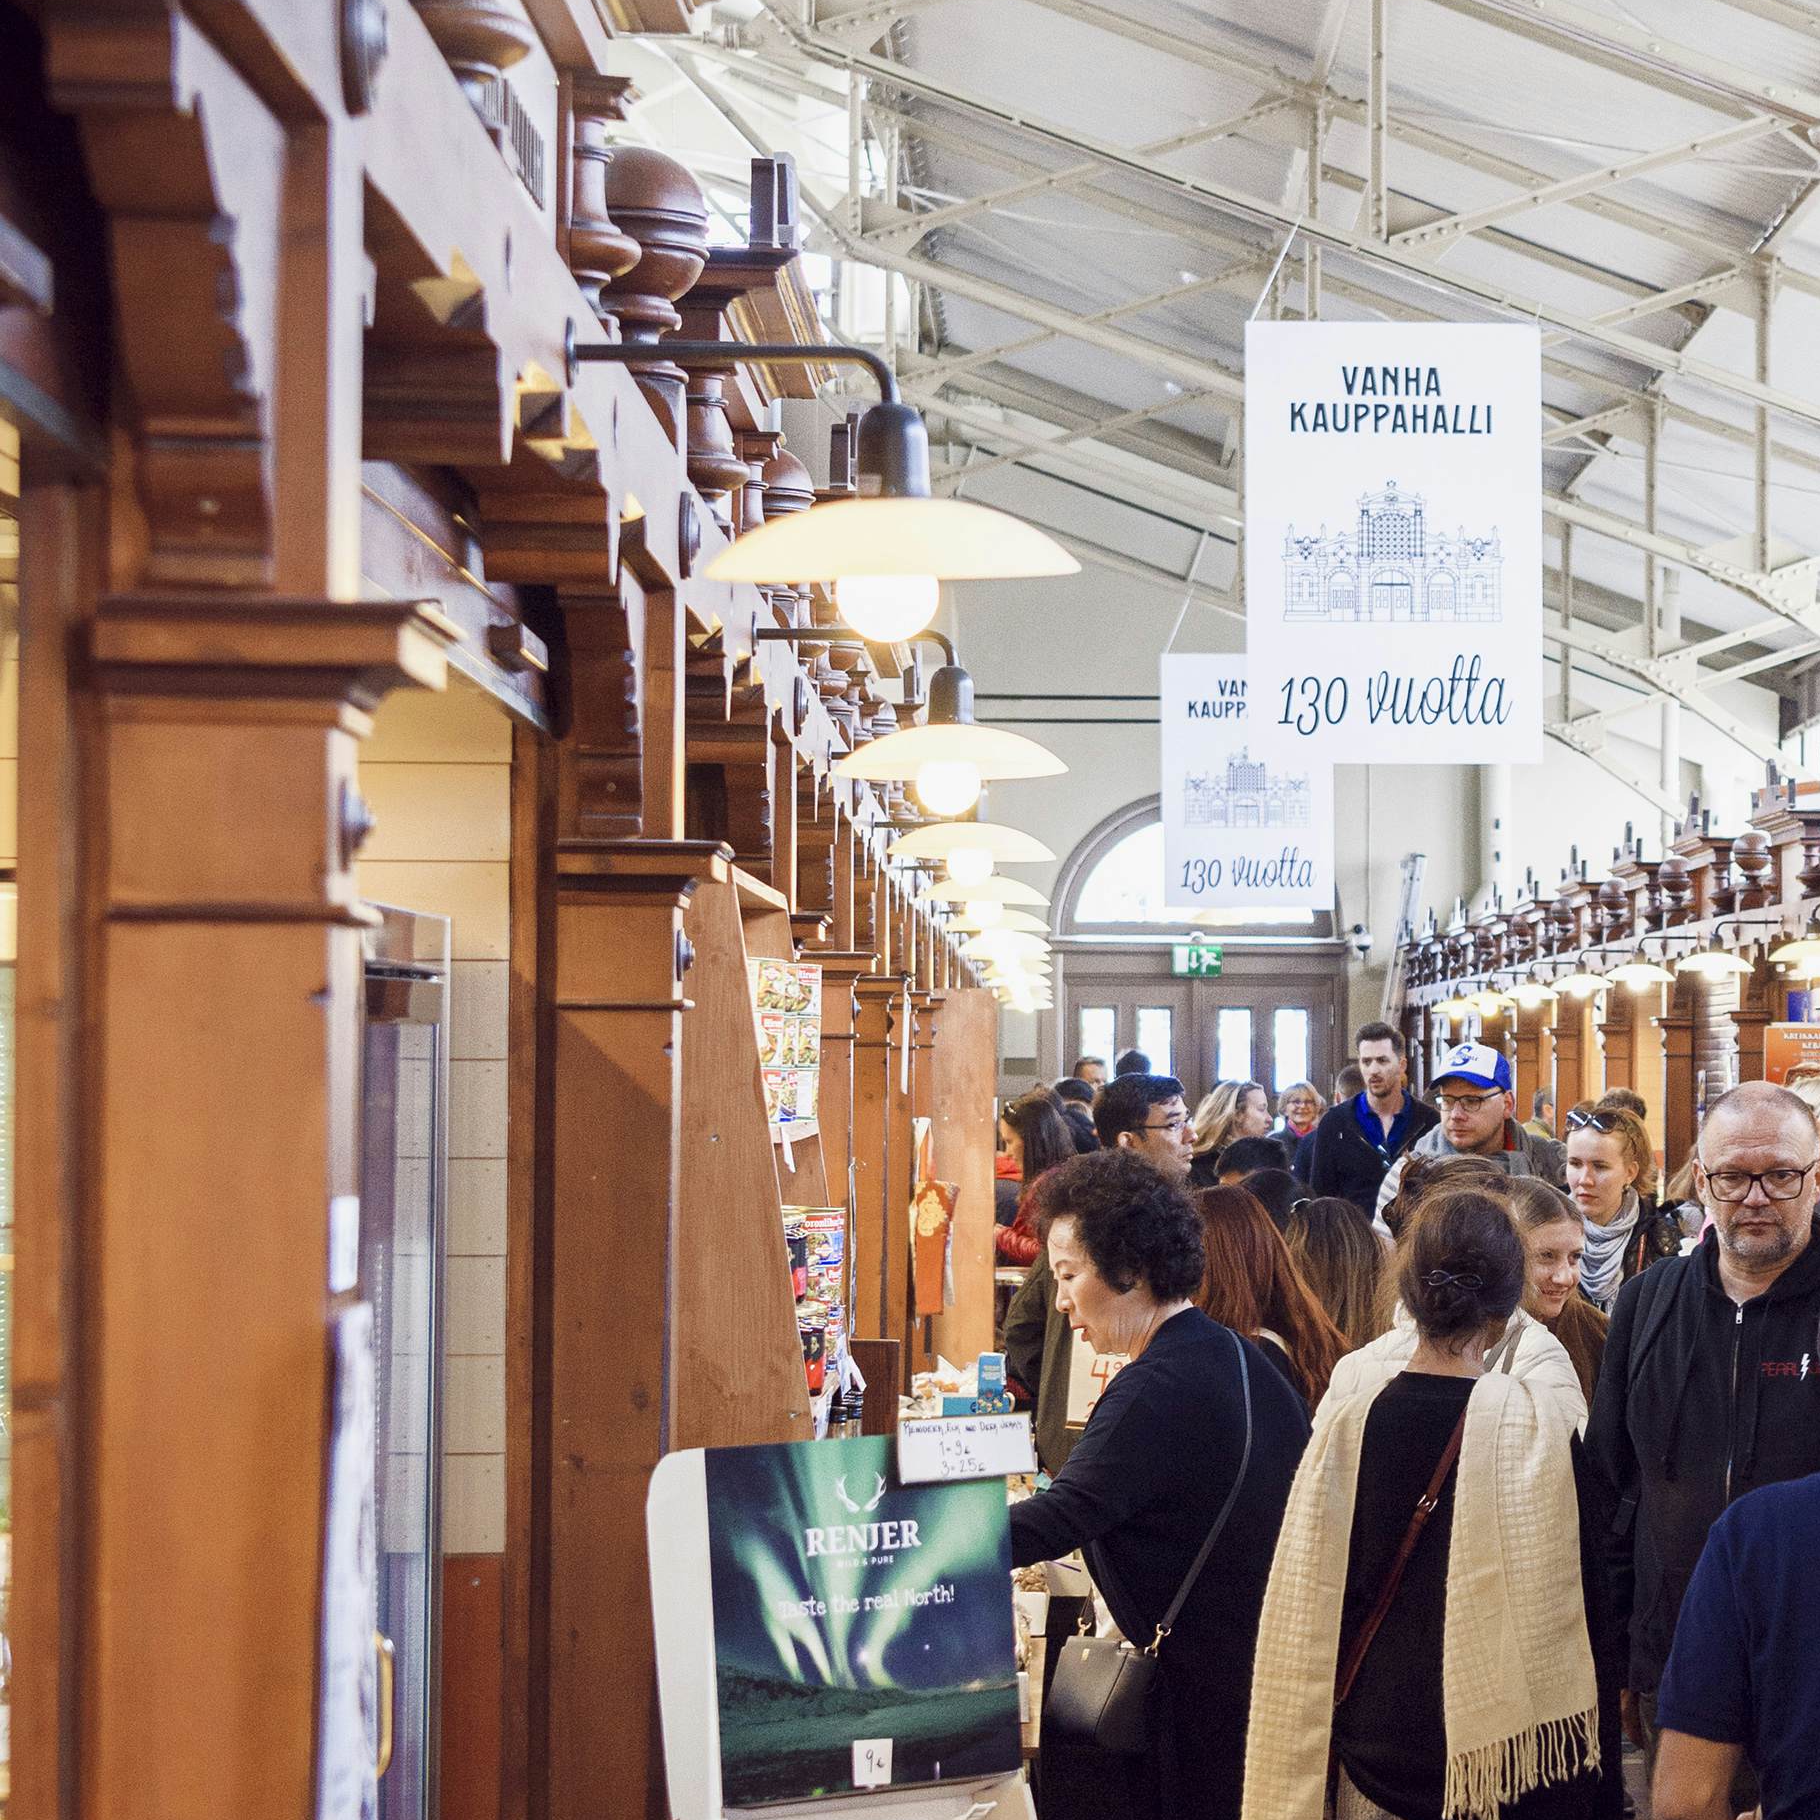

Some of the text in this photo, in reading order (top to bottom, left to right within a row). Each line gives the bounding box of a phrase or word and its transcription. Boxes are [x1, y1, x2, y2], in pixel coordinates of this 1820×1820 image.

[1341, 366, 1441, 396] VANHA
[1290, 402, 1493, 434] KAUPPAHALLI
[1187, 700, 1248, 719] KAUPP
[1277, 654, 1513, 735] 130 vuotta
[1181, 845, 1316, 894] 130 vuotta
[805, 1519, 922, 1557] RENJER
[872, 1554, 894, 1566] PURE
[834, 1593, 860, 1613] the
[864, 1588, 898, 1611] real
[901, 1583, 955, 1607] North!
